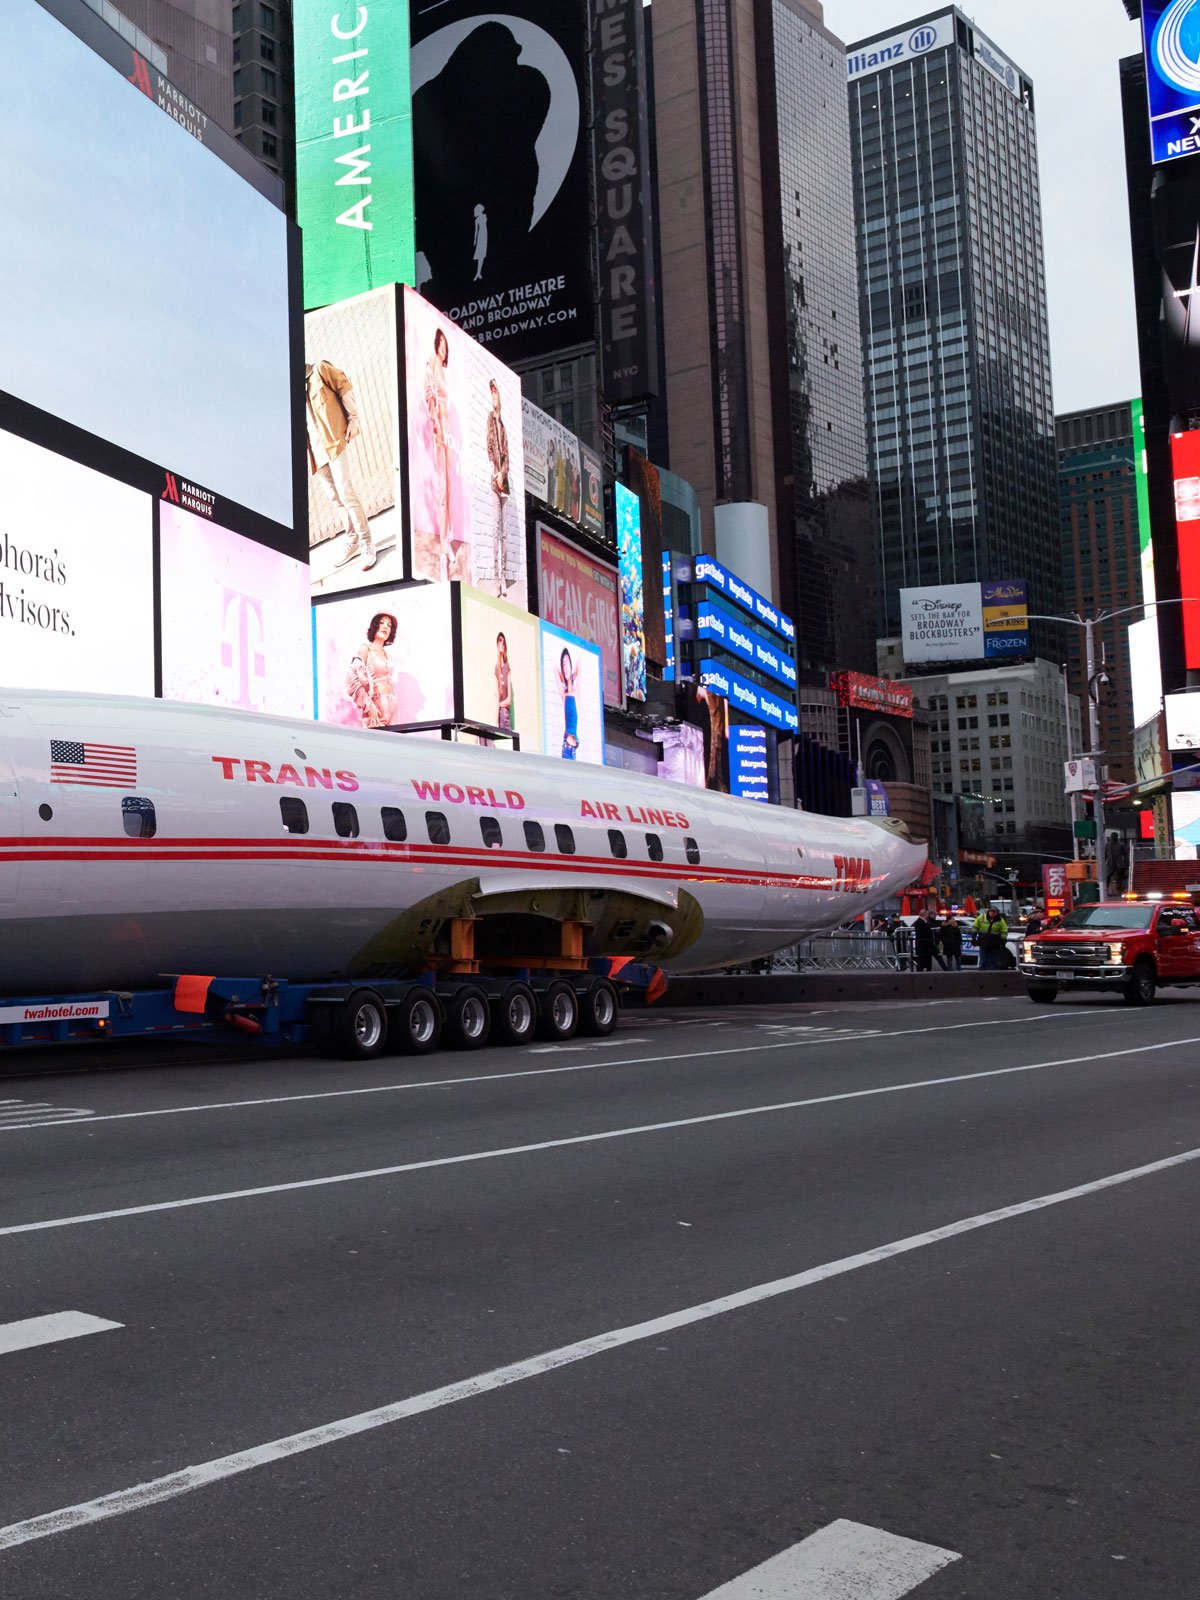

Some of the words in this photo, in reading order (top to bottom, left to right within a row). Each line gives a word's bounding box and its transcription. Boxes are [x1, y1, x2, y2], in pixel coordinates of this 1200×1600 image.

[980, 42, 1005, 80] Allianz
[157, 76, 207, 129] MARRIOTT
[158, 94, 203, 142] MARQUIS
[602, 108, 638, 342] SQUARE
[508, 275, 566, 303] THEATRE
[462, 314, 485, 330] AND
[488, 295, 552, 323] BROADWAY
[181, 481, 216, 505] MARRIOTT
[181, 494, 212, 516] MARQUIS
[542, 568, 584, 629] MEAN
[585, 591, 618, 653] GIRLS
[910, 613, 927, 621] SETS
[942, 611, 955, 619] BAR
[957, 610, 971, 618] FOR
[917, 618, 965, 630] BROADWAY
[986, 638, 1027, 650] FROZEN
[211, 756, 360, 793] TRANS
[410, 778, 527, 811] WORLD
[579, 799, 621, 821] AIR
[628, 805, 691, 830] LINES
[870, 799, 886, 810] BEST
[833, 855, 871, 894] TWA
[1049, 866, 1066, 896] tkts
[24, 1004, 100, 1020] twahotel.com
